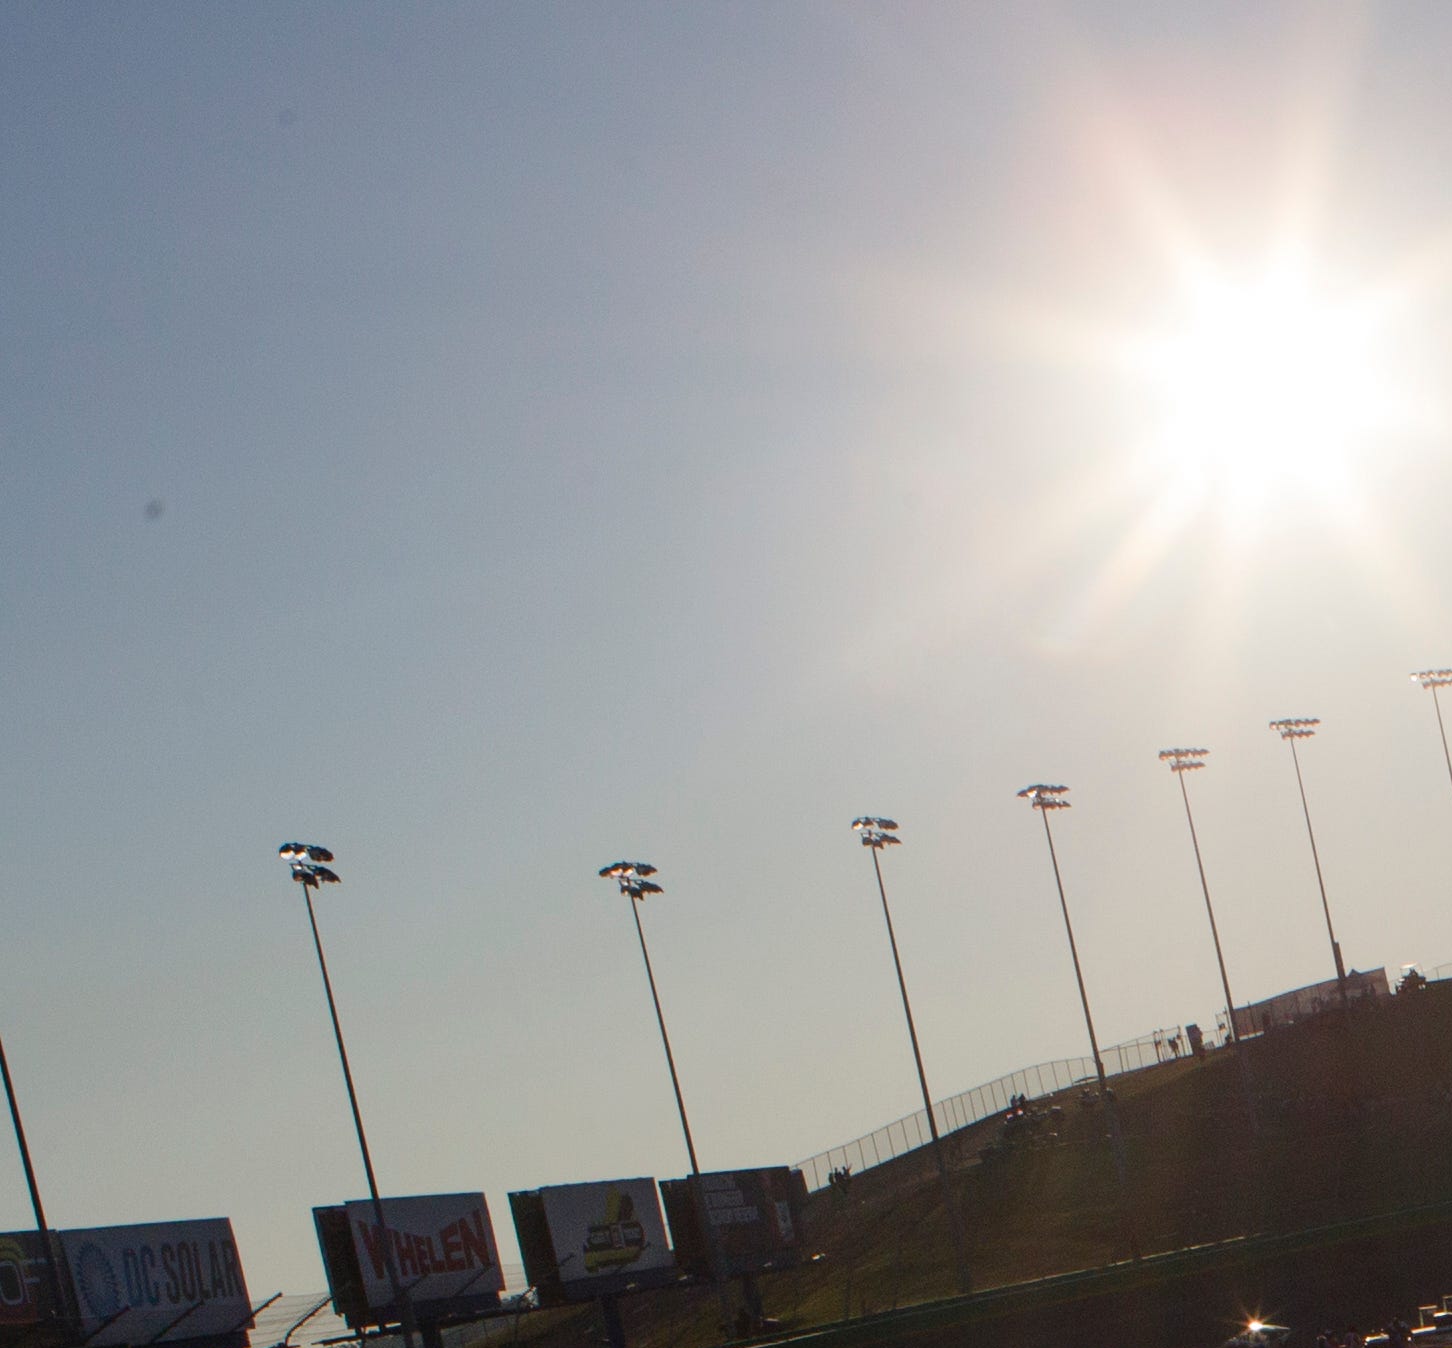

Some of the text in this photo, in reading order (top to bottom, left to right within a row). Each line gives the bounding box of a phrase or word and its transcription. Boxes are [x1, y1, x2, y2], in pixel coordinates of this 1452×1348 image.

[123, 1240, 243, 1307] DC SOLAR
[357, 1209, 491, 1280] WHELEN
